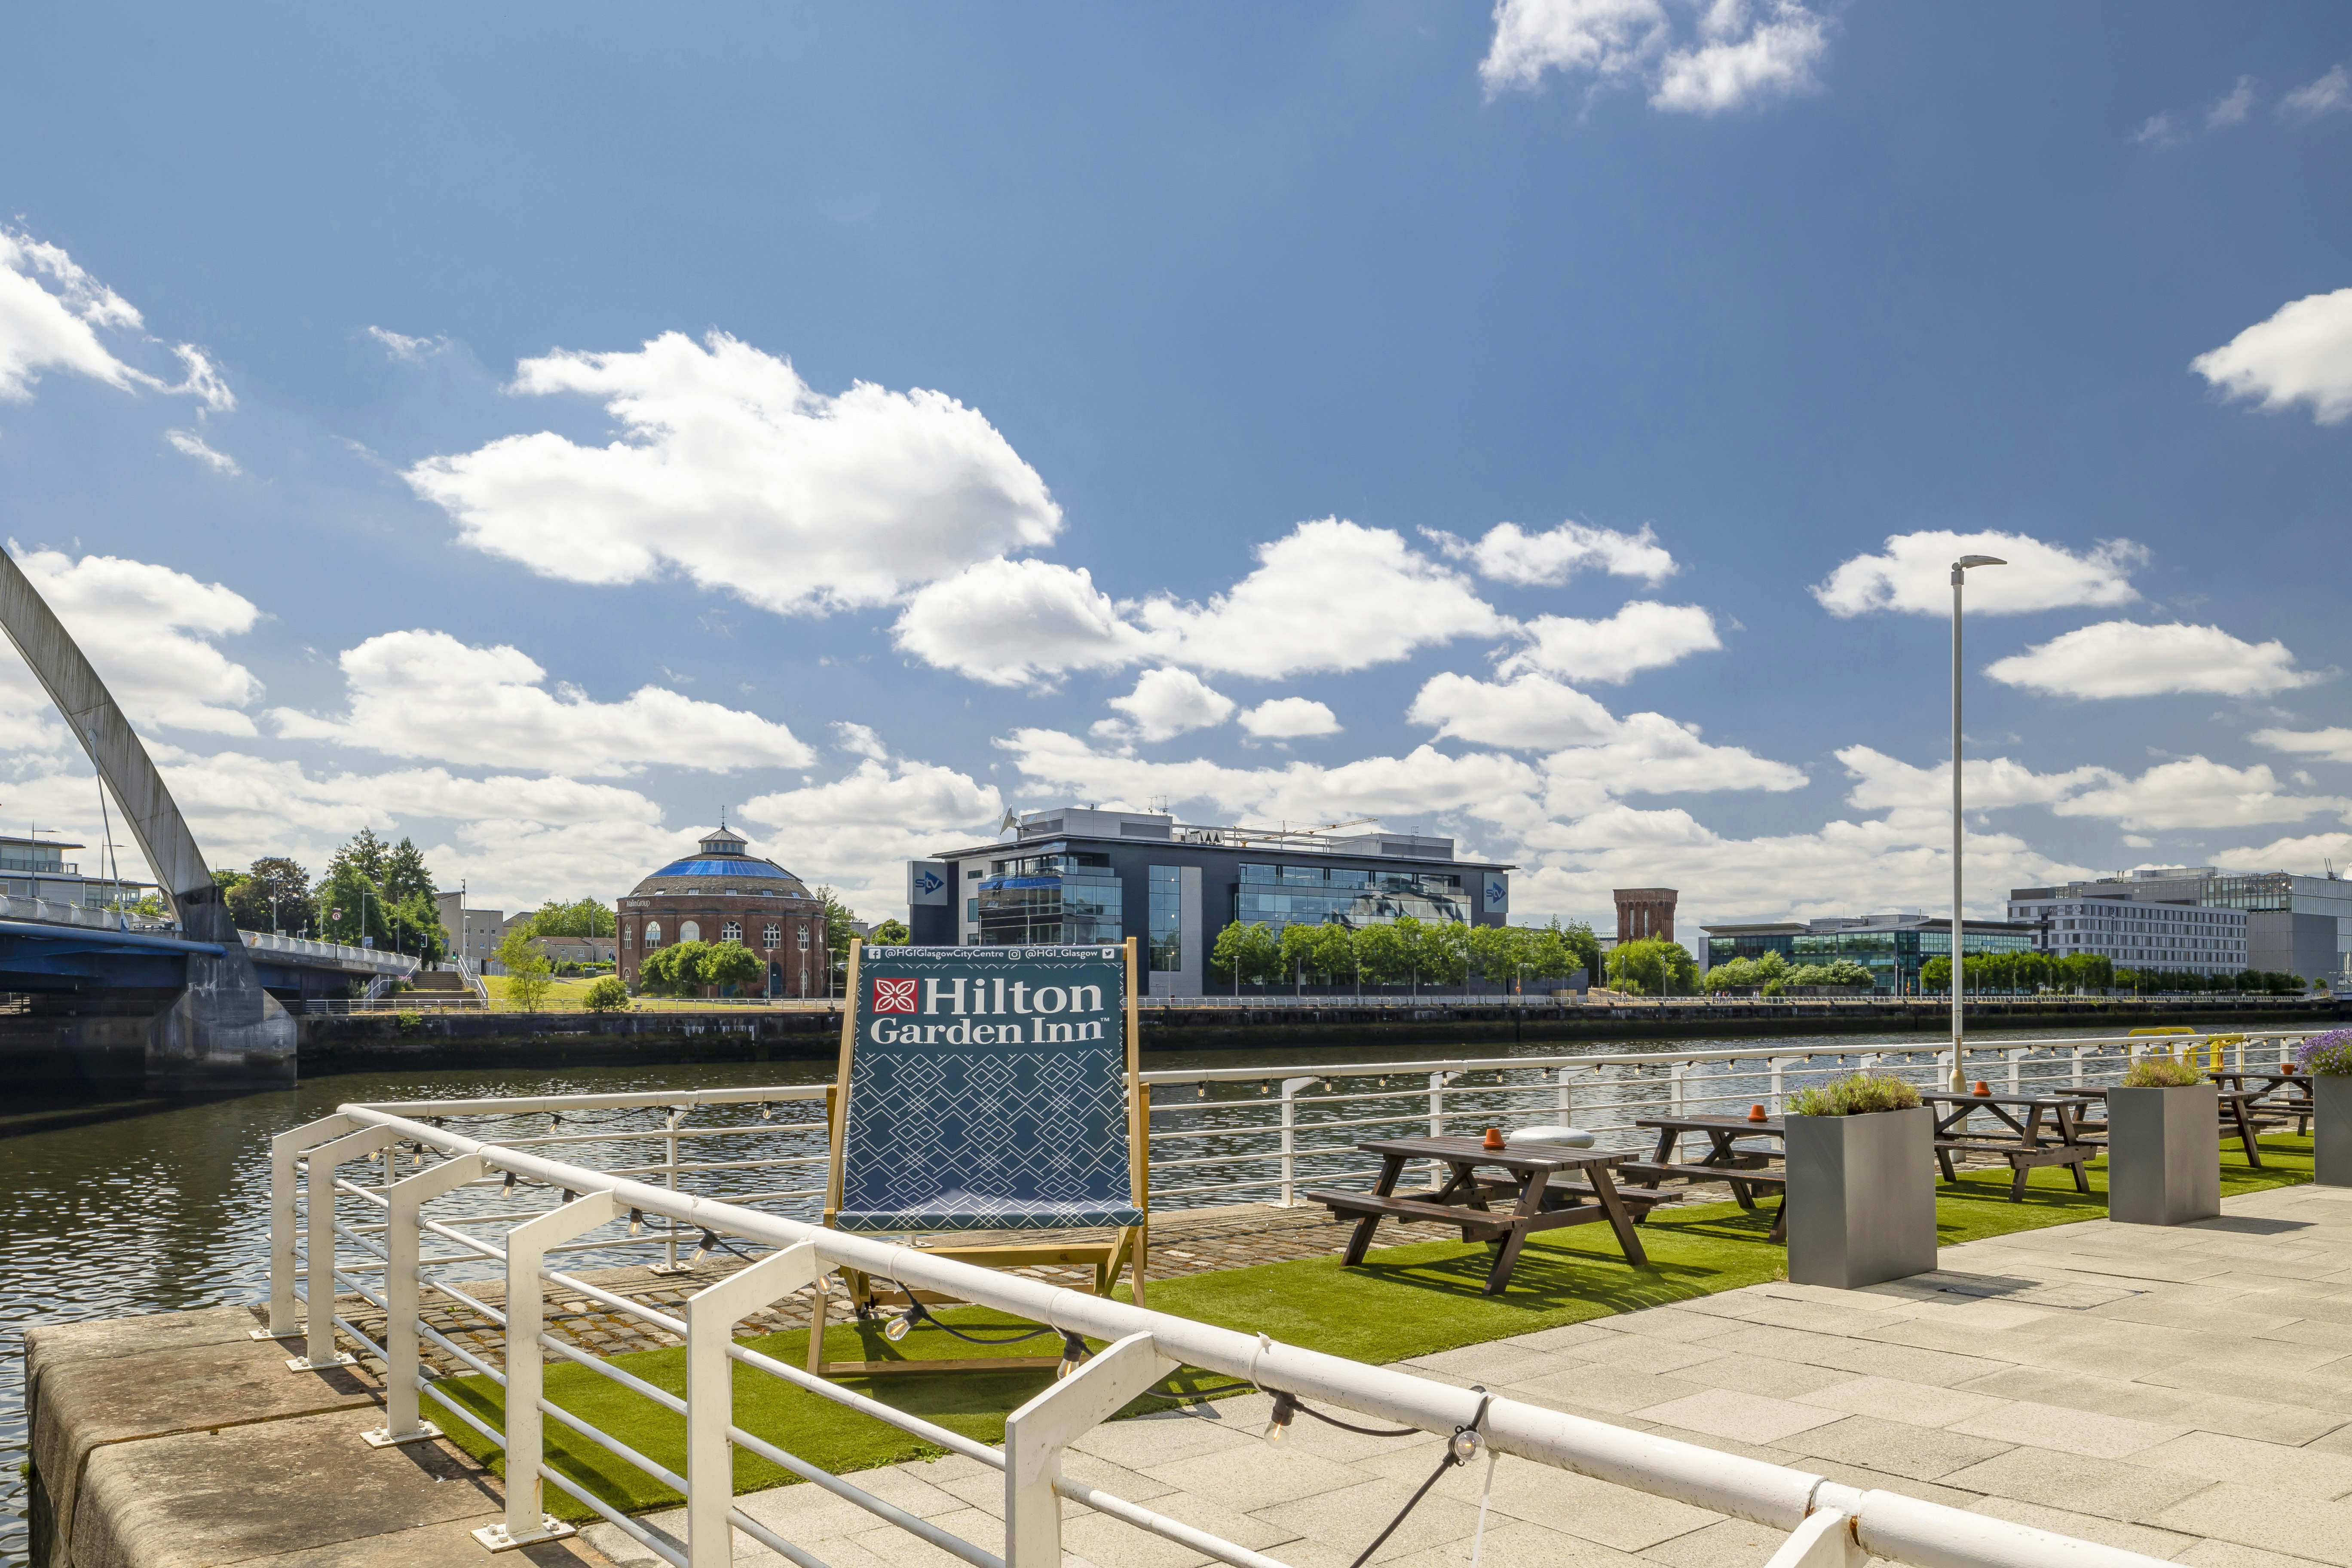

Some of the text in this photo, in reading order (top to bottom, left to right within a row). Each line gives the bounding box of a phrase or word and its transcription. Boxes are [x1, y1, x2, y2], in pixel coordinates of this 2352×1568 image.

[915, 877, 940, 888] stv
[1486, 888, 1503, 897] stv
[885, 949, 1004, 959] @HGIGlasgowCityCentre
[1025, 949, 1098, 959] @HGI_Glasgow
[923, 978, 1104, 1015] Hilton
[870, 1017, 1025, 1044] Garden
[1031, 1017, 1104, 1043] Inn
